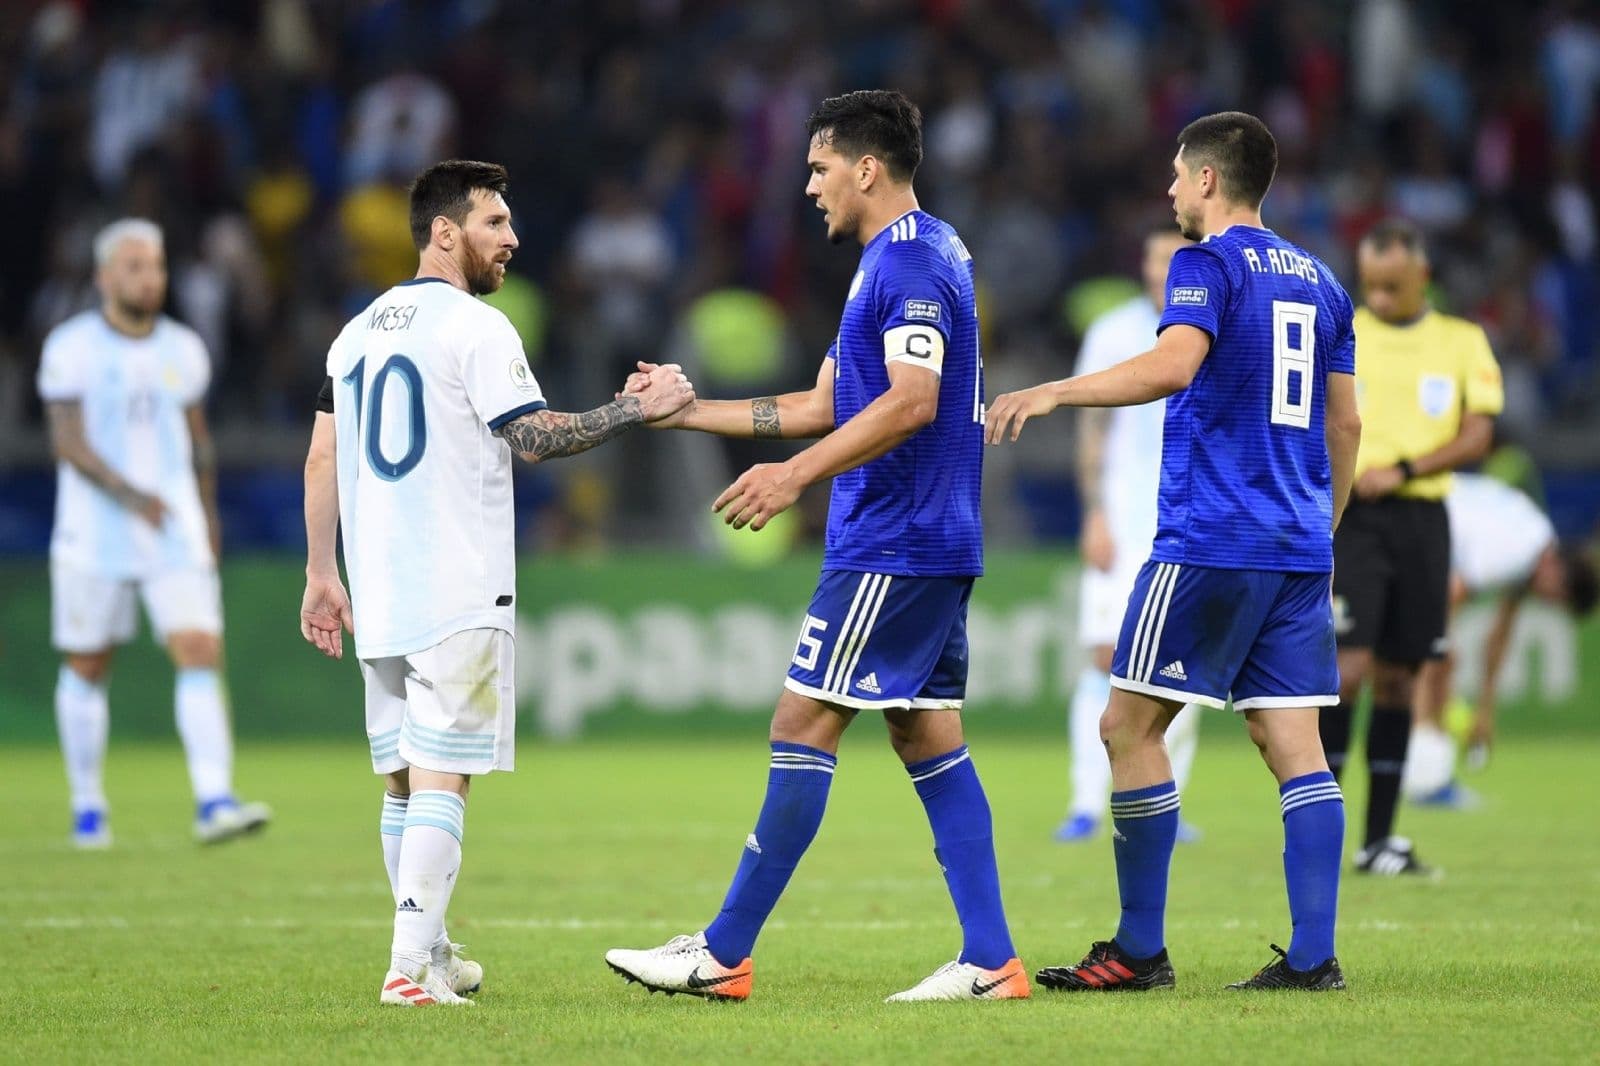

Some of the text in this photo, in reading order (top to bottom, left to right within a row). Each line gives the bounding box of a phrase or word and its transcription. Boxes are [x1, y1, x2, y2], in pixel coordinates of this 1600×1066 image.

[366, 305, 418, 331] MESSI
[907, 309, 936, 318] grande
[906, 333, 931, 359] C
[1271, 300, 1317, 429] 8
[342, 353, 427, 482] 10
[792, 613, 829, 672] 5
[1159, 669, 1188, 681] adidas
[855, 682, 882, 695] adidas
